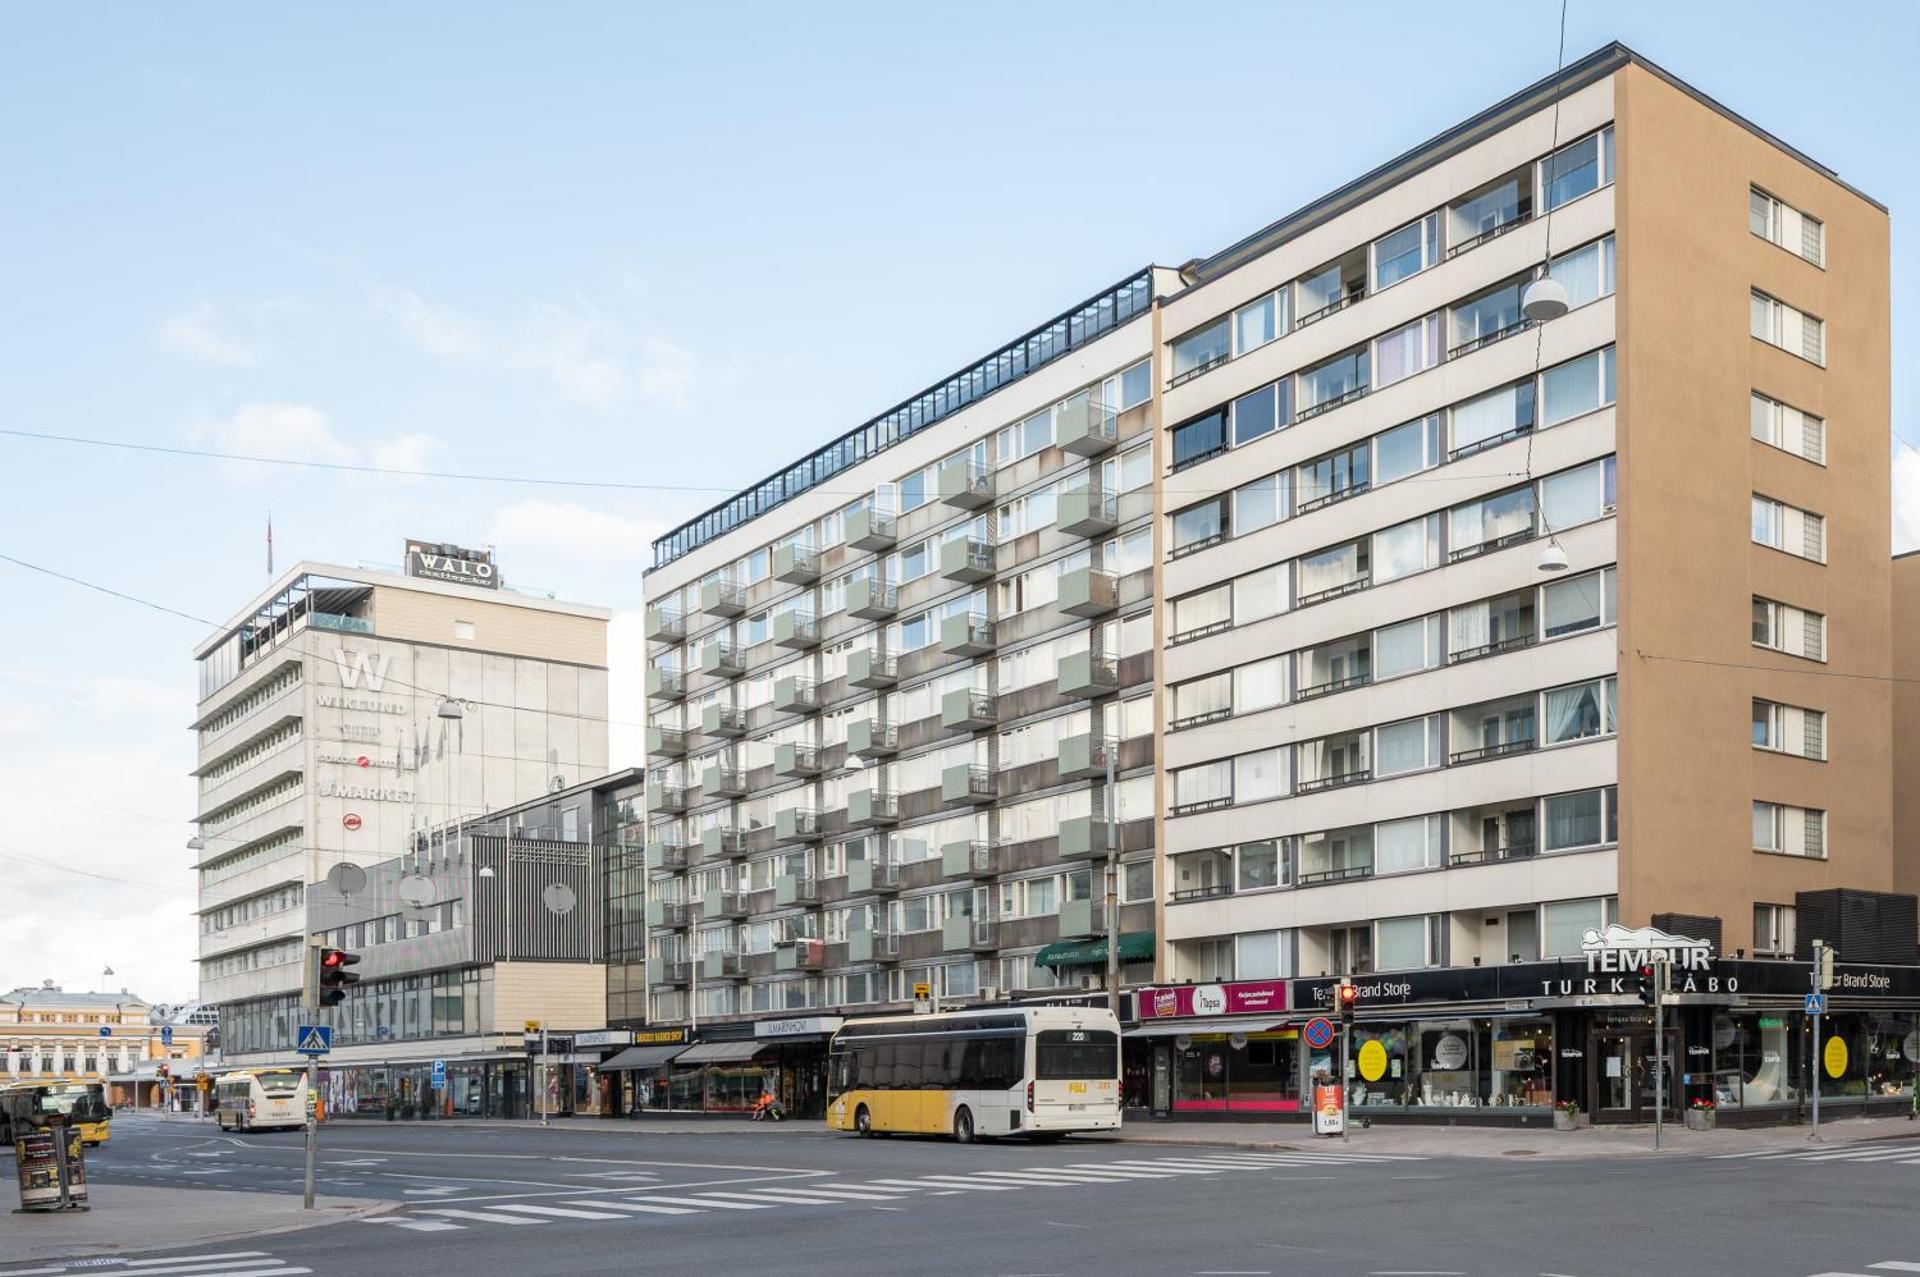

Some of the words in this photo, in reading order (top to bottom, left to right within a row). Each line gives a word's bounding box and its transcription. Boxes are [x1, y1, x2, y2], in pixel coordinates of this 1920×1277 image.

[419, 553, 492, 578] WALO
[333, 648, 390, 691] W
[1541, 977, 1648, 995] TURK
[1683, 973, 1738, 993] ÅBO
[1843, 973, 1868, 988] Brand
[1869, 974, 1891, 989] Store
[1352, 982, 1381, 999] Brand
[1383, 982, 1412, 997] Store
[1072, 1032, 1084, 1040] 220
[434, 1061, 444, 1074] P
